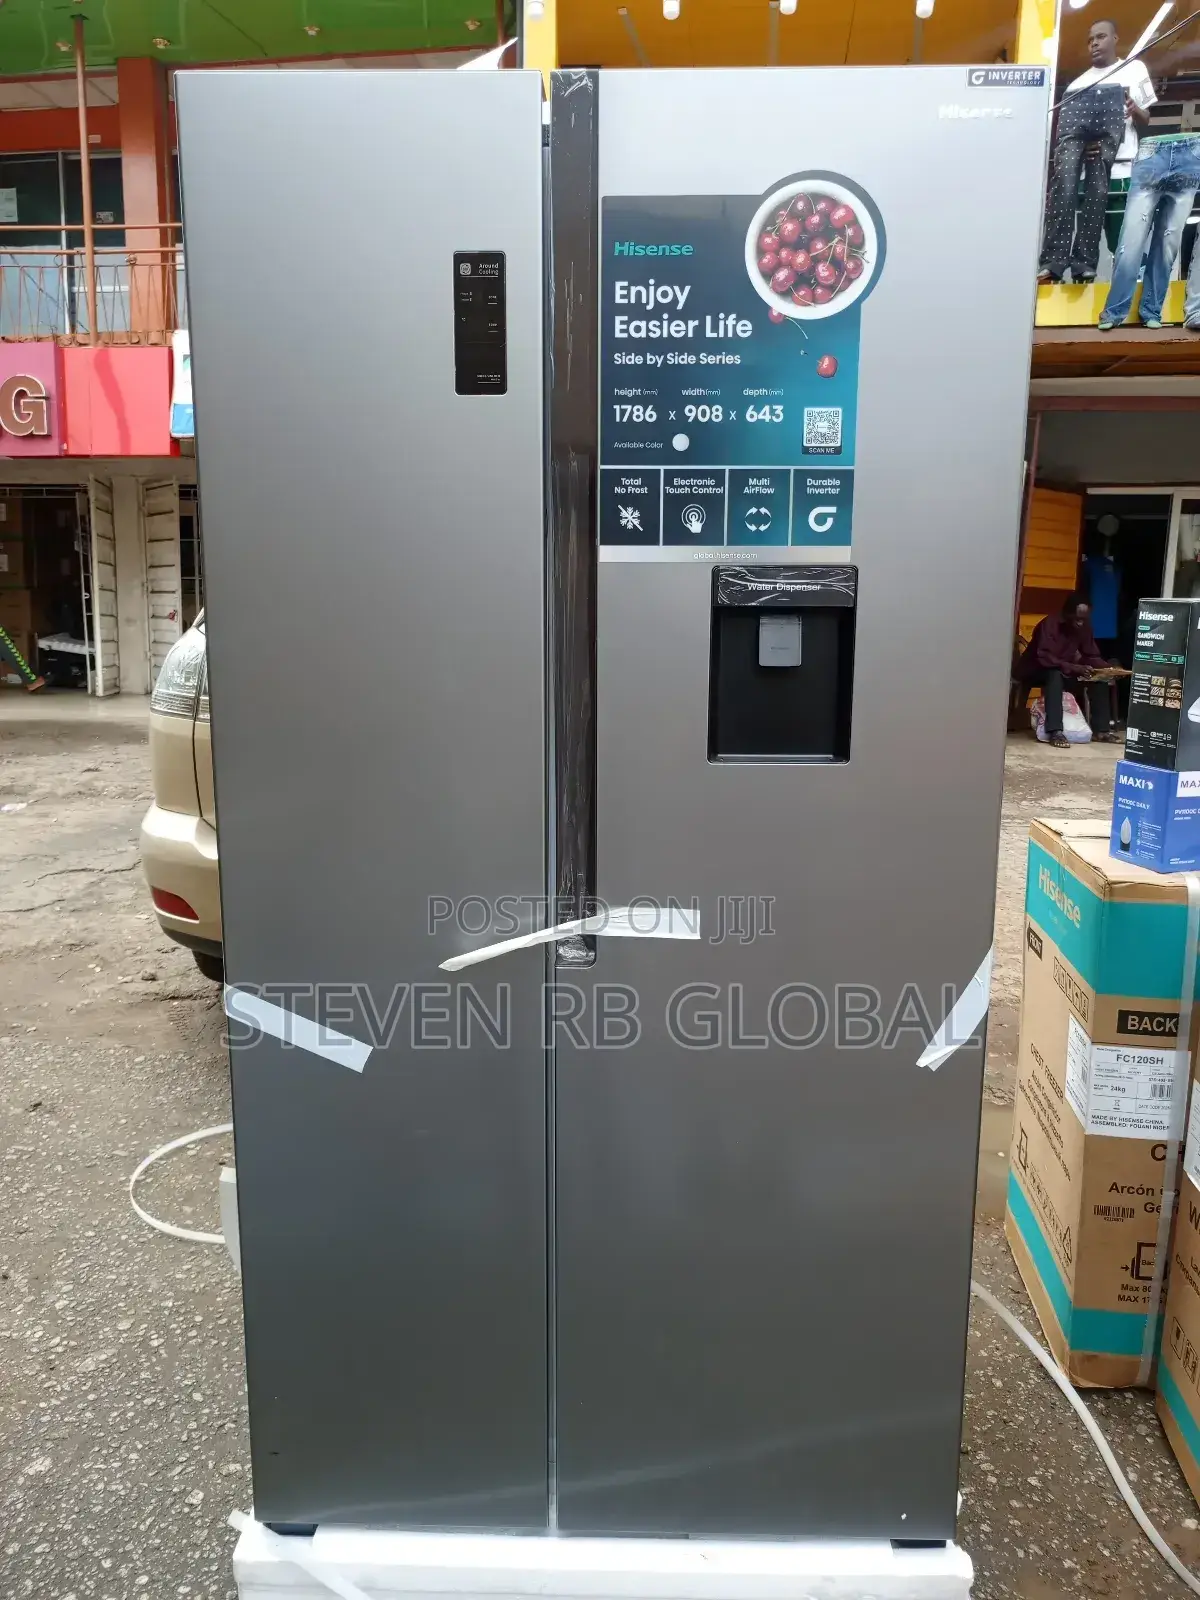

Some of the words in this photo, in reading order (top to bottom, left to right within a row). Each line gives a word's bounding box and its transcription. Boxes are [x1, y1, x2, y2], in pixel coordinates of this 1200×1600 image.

[988, 71, 1041, 80] INVERTER
[613, 241, 694, 256] Hisense
[614, 278, 692, 310] Enjoy
[614, 313, 699, 339] Easier
[705, 312, 753, 338] Life
[613, 352, 643, 365] Side
[646, 352, 664, 367] by
[666, 352, 696, 365] Side
[699, 352, 741, 365] Series
[614, 388, 642, 398] height
[743, 388, 768, 398] depth
[613, 404, 658, 423] 1786
[668, 410, 677, 421] x
[684, 404, 723, 423] 908
[729, 410, 737, 421] x
[745, 404, 784, 423] 643
[613, 441, 644, 449] Available
[645, 441, 664, 449] Color
[620, 477, 642, 486] Total
[673, 477, 716, 486] Electronic
[748, 477, 770, 486] Multi
[806, 478, 841, 486] Durable
[614, 486, 626, 494] No
[627, 486, 648, 494] Frost
[664, 486, 691, 494] Touch
[692, 486, 724, 494] Control
[743, 486, 775, 494] AirFlow
[806, 486, 841, 495] Inverter
[747, 583, 774, 591] Water
[776, 583, 821, 592] Dispenser
[1138, 611, 1174, 622] Hisense
[1137, 632, 1165, 641] SANDWICH
[1119, 774, 1145, 789] MAXI
[1038, 863, 1081, 929] Hisense
[1127, 1015, 1178, 1033] BACK
[1116, 1053, 1164, 1065] FC120SH
[1110, 1085, 1126, 1094] 24kg
[1118, 1116, 1144, 1124] HISENSE
[1108, 1181, 1155, 1197] Arcón
[1120, 1283, 1140, 1292] Max
[1117, 1294, 1139, 1303] MAX
